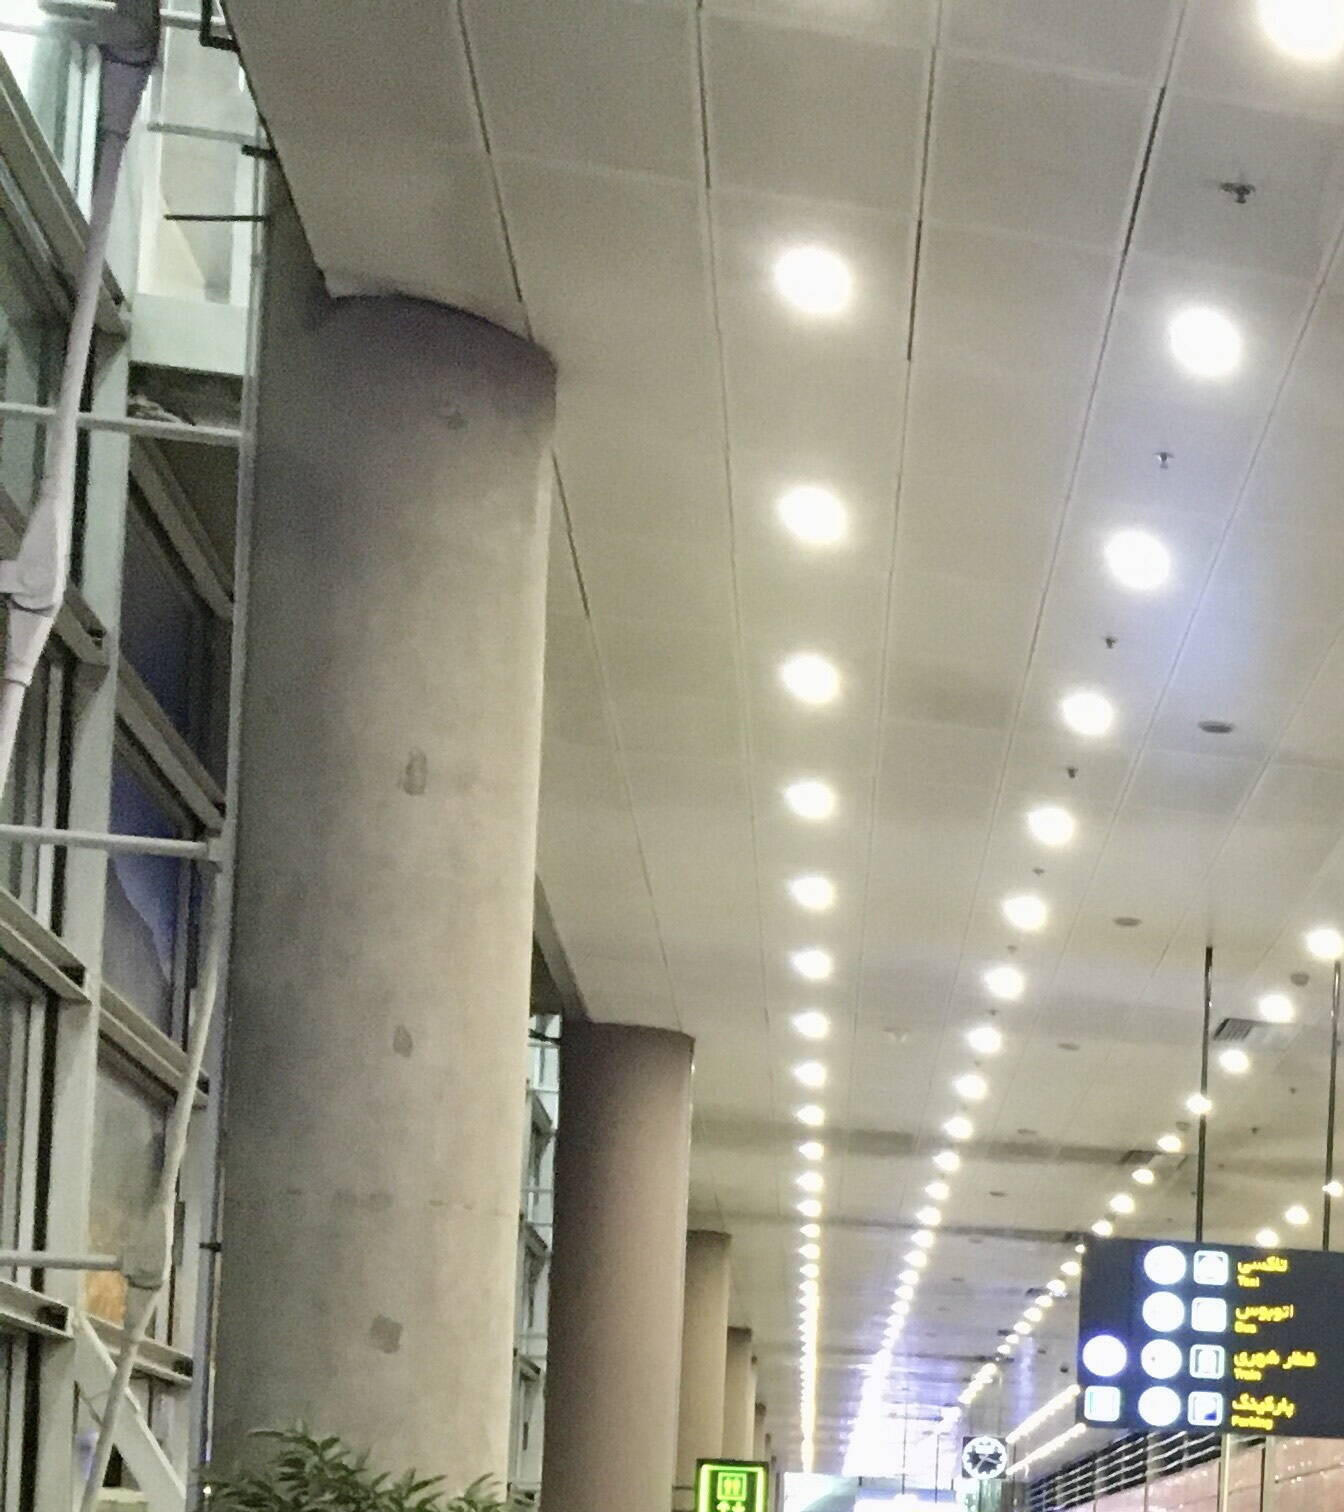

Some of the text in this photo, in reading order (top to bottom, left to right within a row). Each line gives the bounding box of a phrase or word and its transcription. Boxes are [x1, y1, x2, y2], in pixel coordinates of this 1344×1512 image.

[1237, 1255, 1288, 1274] تاکسی
[1235, 1303, 1294, 1322] اتوبوس
[1231, 1392, 1295, 1419] پارکینگ
[1231, 1414, 1274, 1431] Parking
